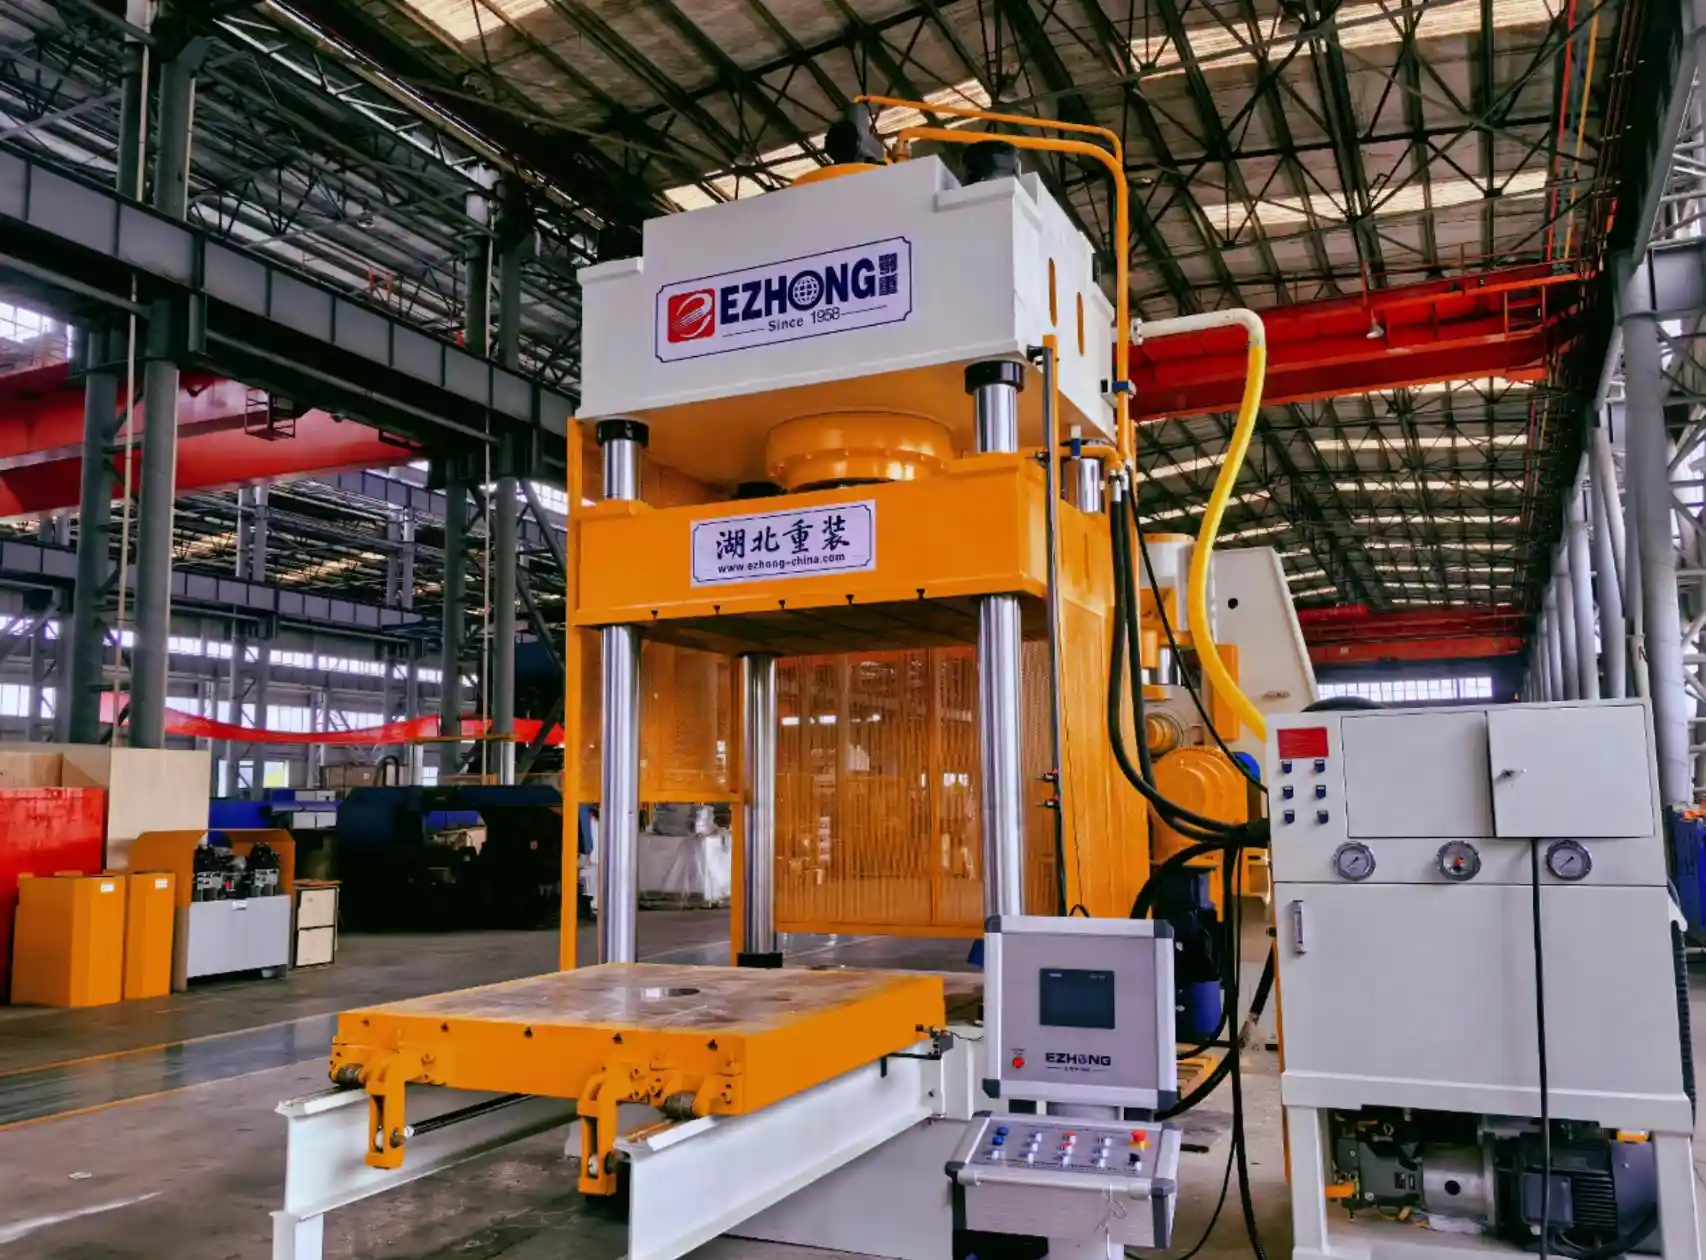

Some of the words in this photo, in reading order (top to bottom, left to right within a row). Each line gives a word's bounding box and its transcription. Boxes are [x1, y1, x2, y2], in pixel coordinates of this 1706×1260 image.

[720, 257, 876, 325] EZHONG
[767, 319, 804, 332] Since
[810, 307, 841, 324] 1958
[716, 515, 850, 559] 湖北重装
[1045, 1052, 1111, 1066] EZHONG
